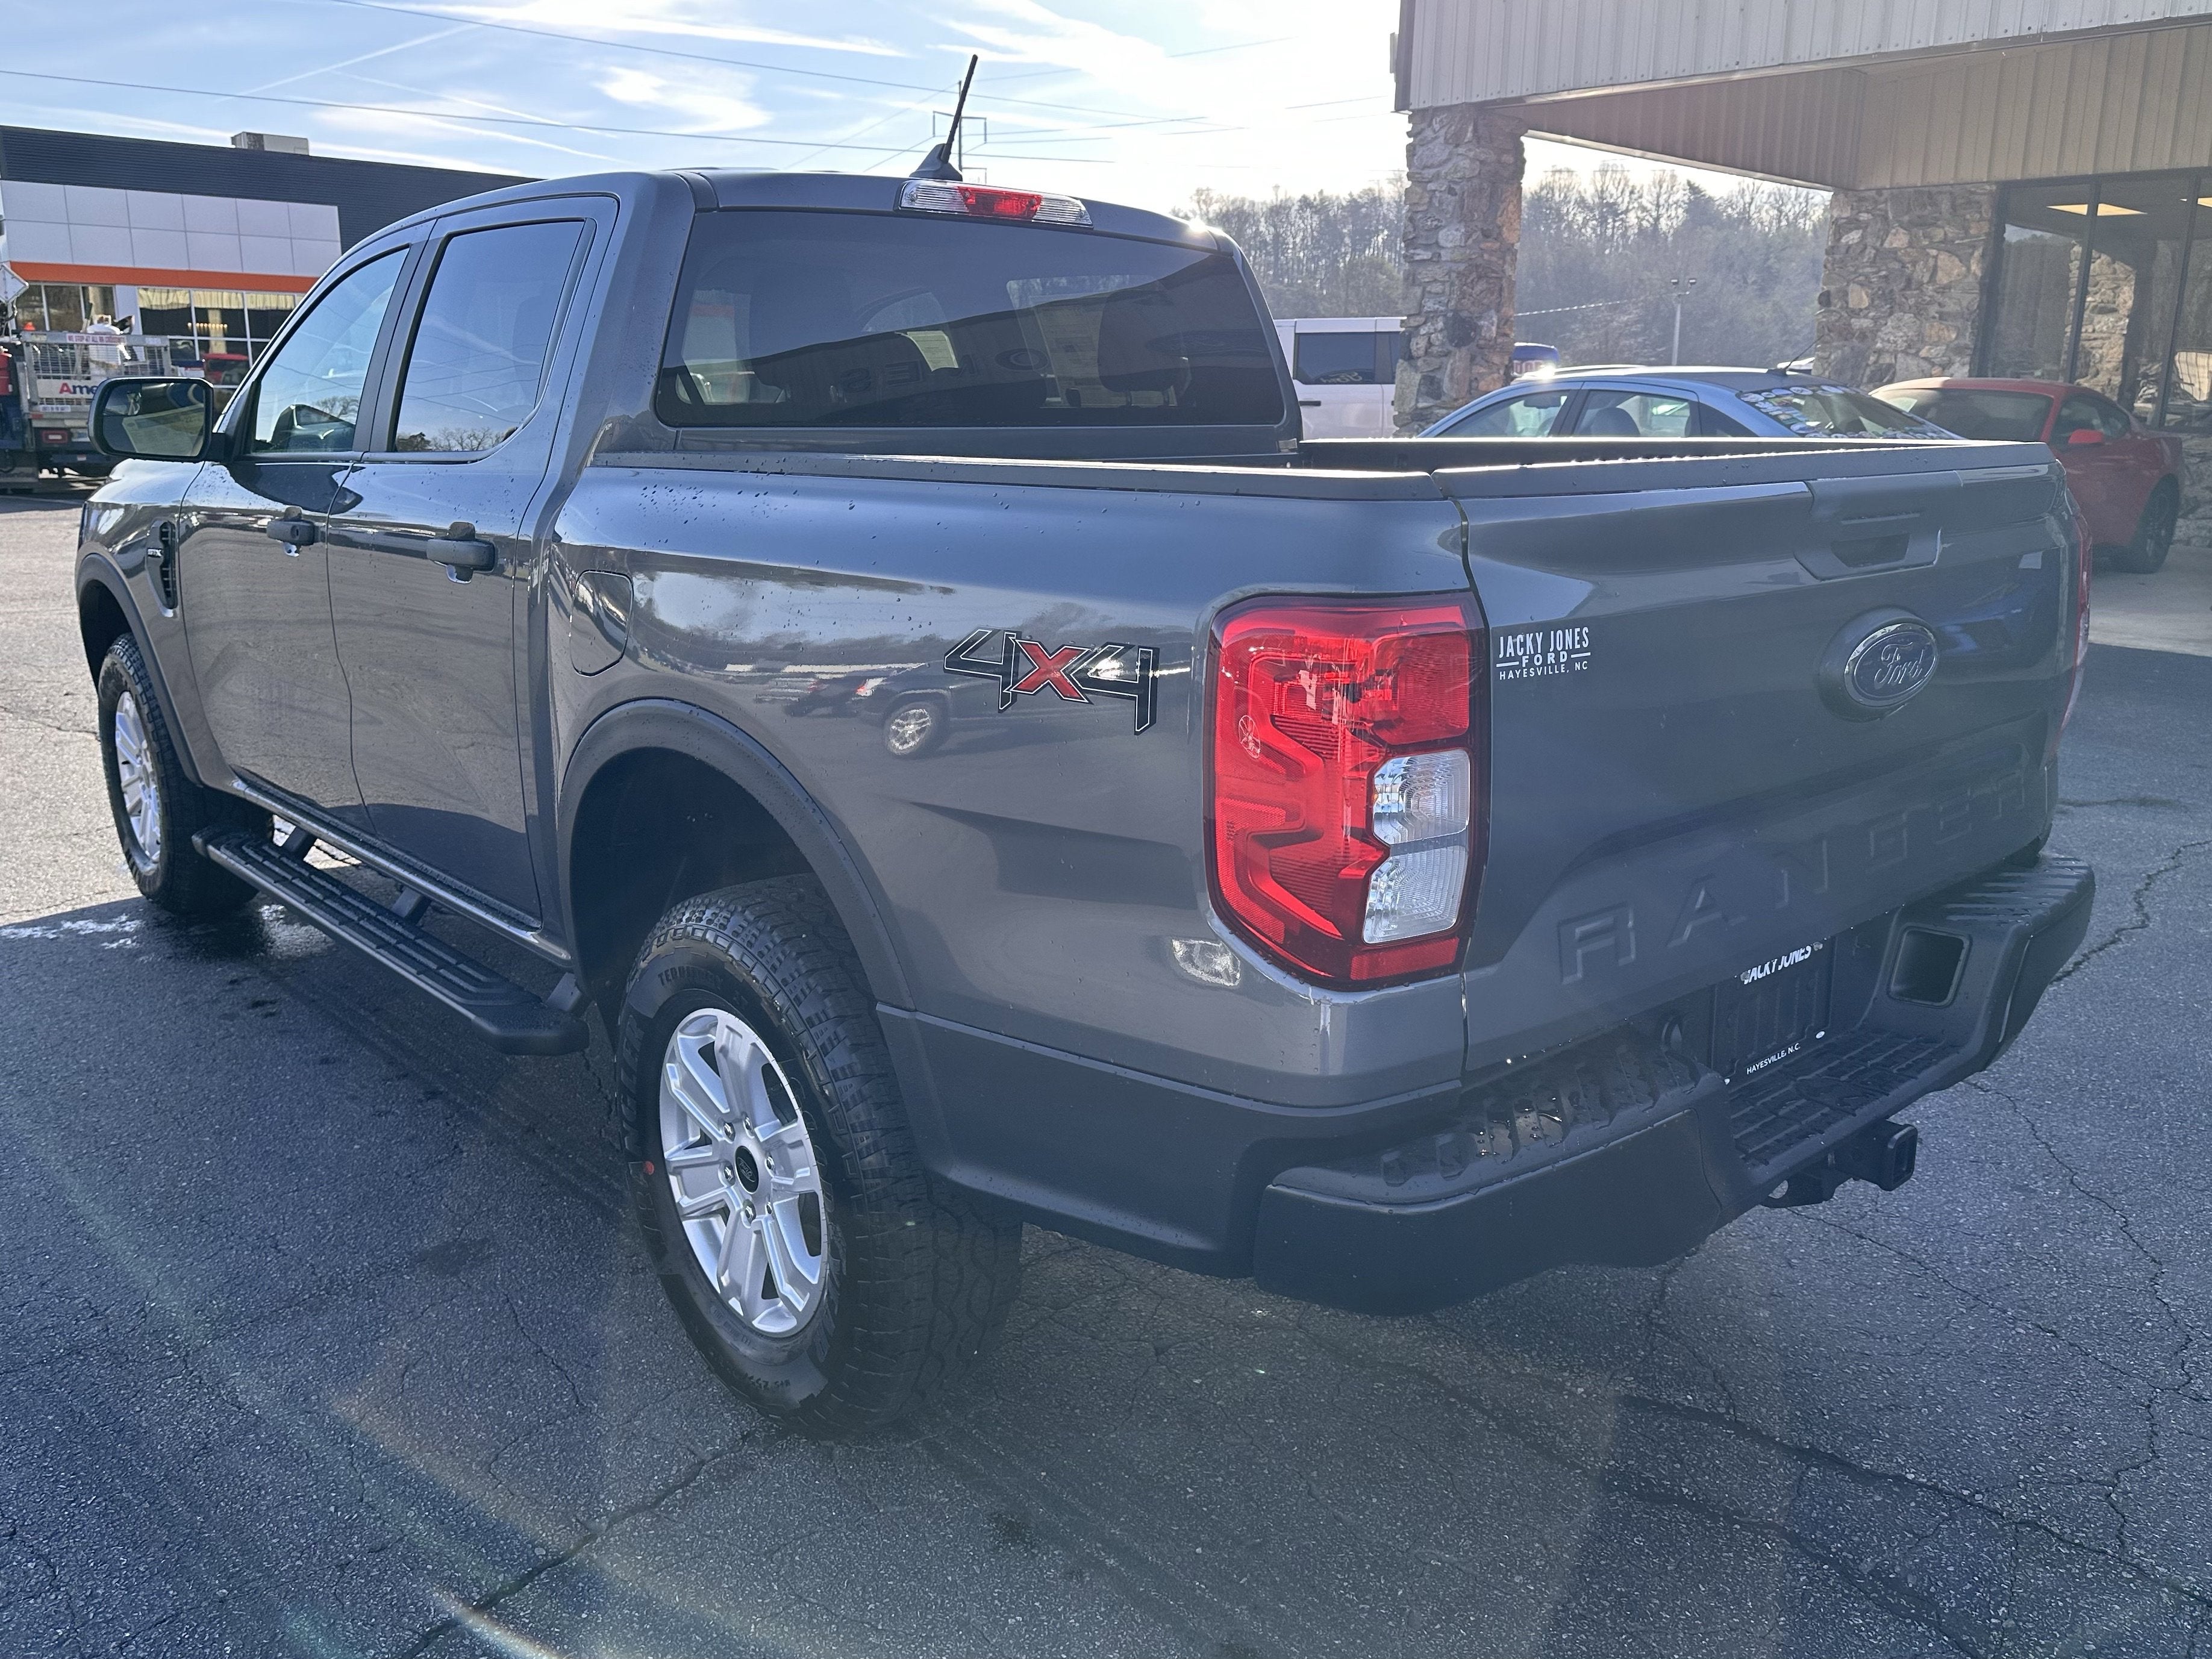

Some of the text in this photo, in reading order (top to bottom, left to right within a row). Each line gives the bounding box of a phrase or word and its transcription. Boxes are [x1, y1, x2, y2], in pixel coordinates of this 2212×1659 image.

[1499, 626, 1589, 658] JACKY JONES
[1499, 660, 1589, 680] HAYESVILLE, NC
[1522, 651, 1567, 667] FORD
[1873, 640, 1924, 690] Ford
[1743, 945, 1812, 985] JACKY JONES
